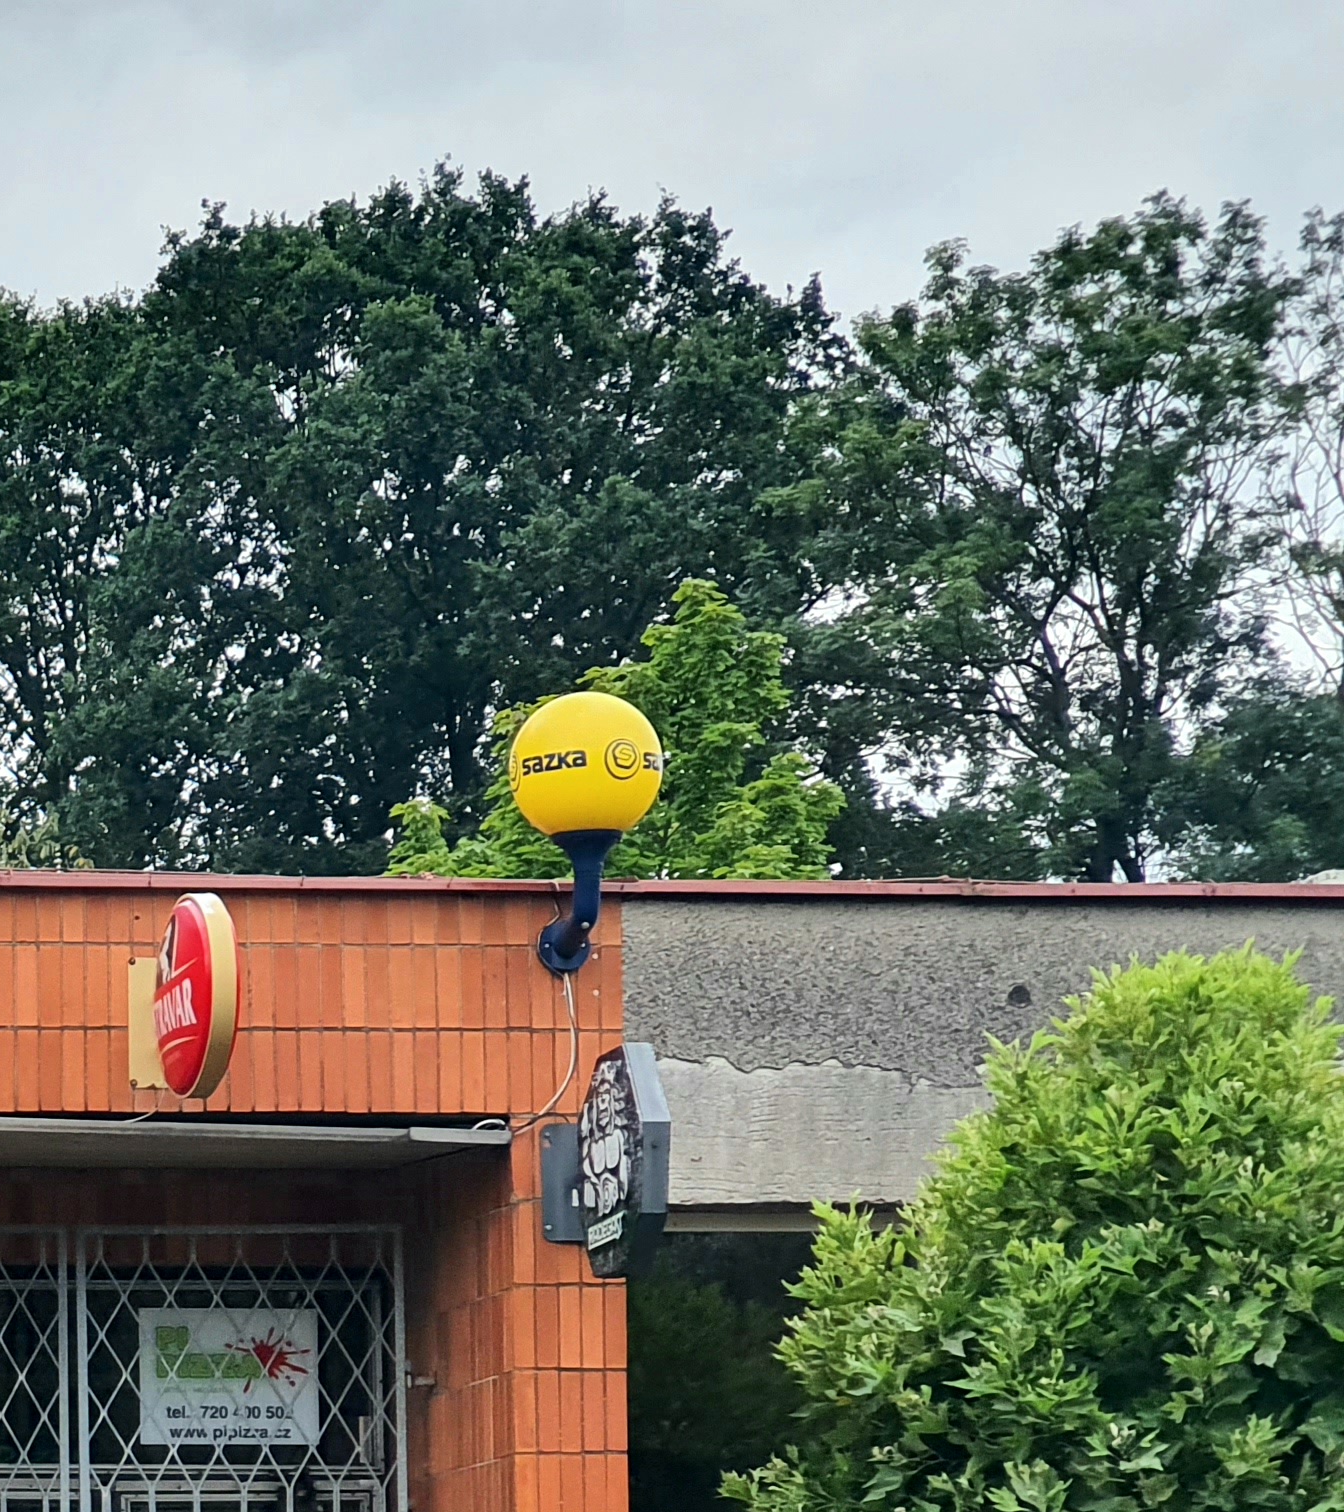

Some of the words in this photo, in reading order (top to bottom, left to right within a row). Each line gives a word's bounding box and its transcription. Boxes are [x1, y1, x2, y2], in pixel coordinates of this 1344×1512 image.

[522, 750, 587, 777] sazka
[154, 977, 197, 1041] RAVAR
[200, 1405, 229, 1419] 720
[265, 1405, 293, 1419] 50
[169, 1425, 292, 1441] wwwpipizza.cz
